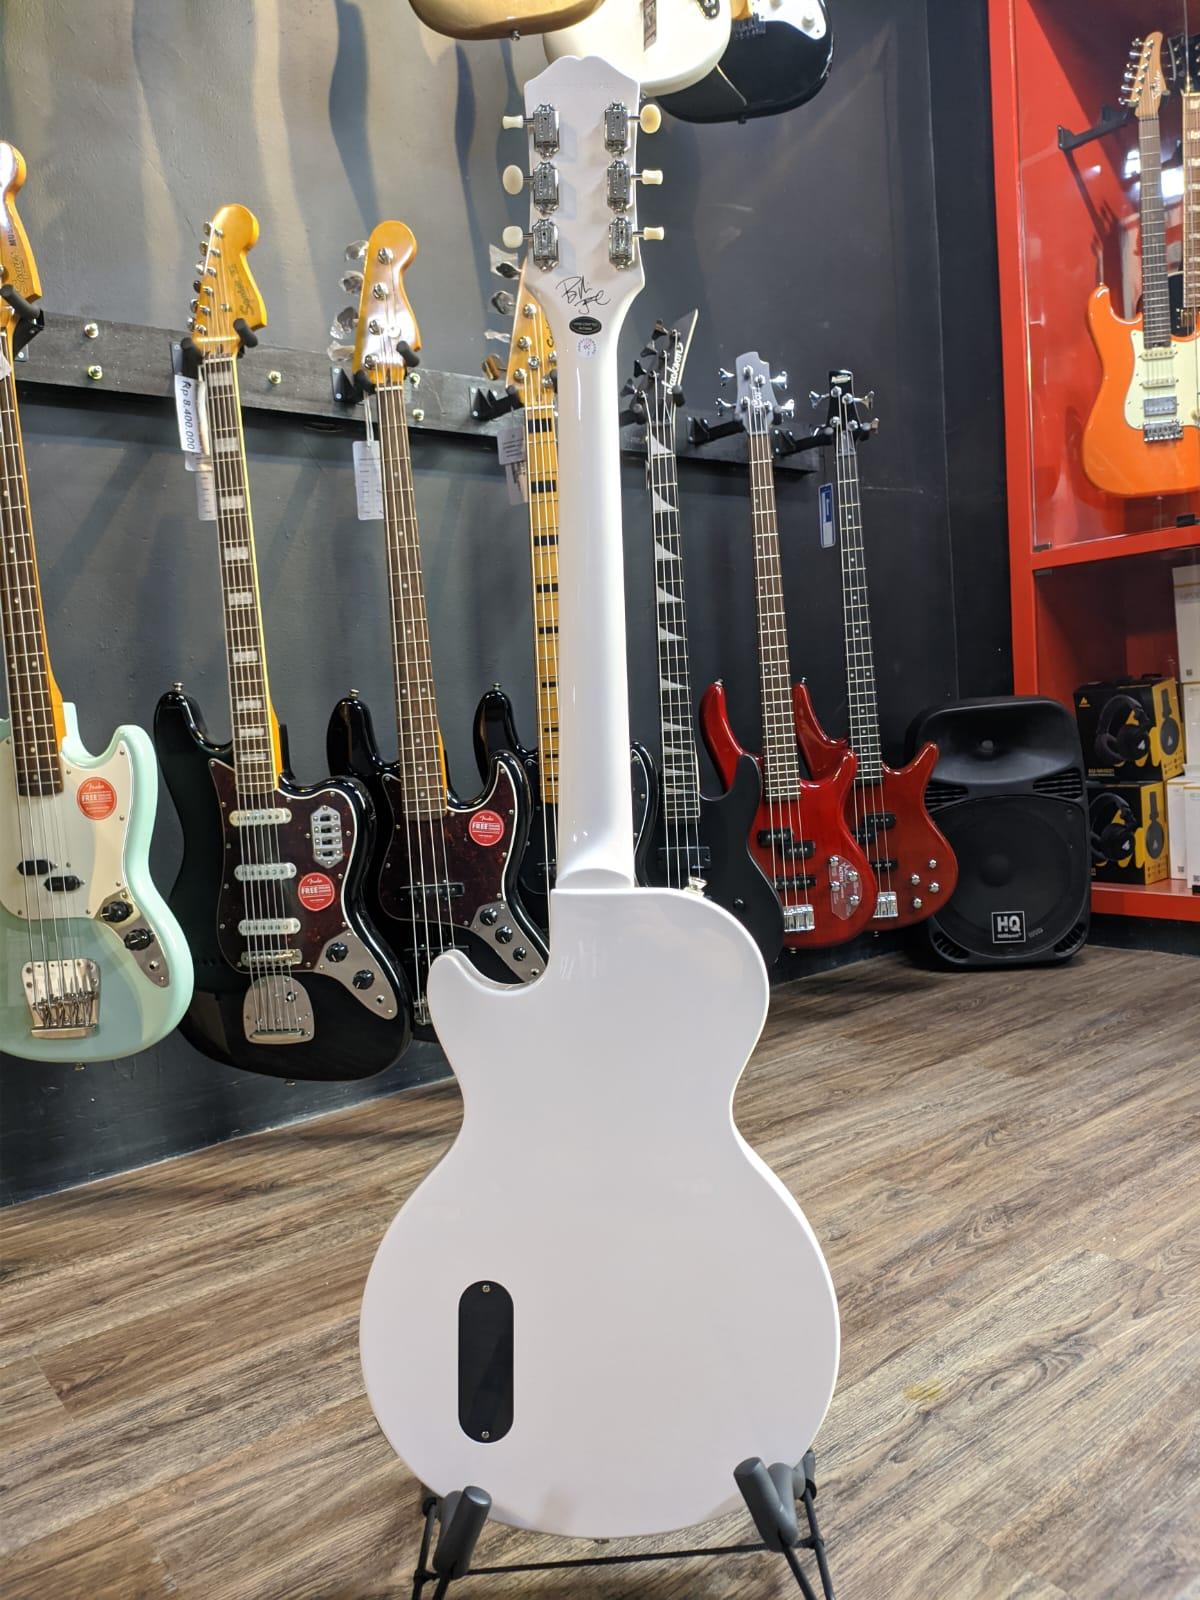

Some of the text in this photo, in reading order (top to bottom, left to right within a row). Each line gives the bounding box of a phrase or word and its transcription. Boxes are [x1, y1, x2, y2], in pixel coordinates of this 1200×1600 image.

[182, 381, 195, 450] Rp 8.400.000
[997, 915, 1021, 932] HQ
